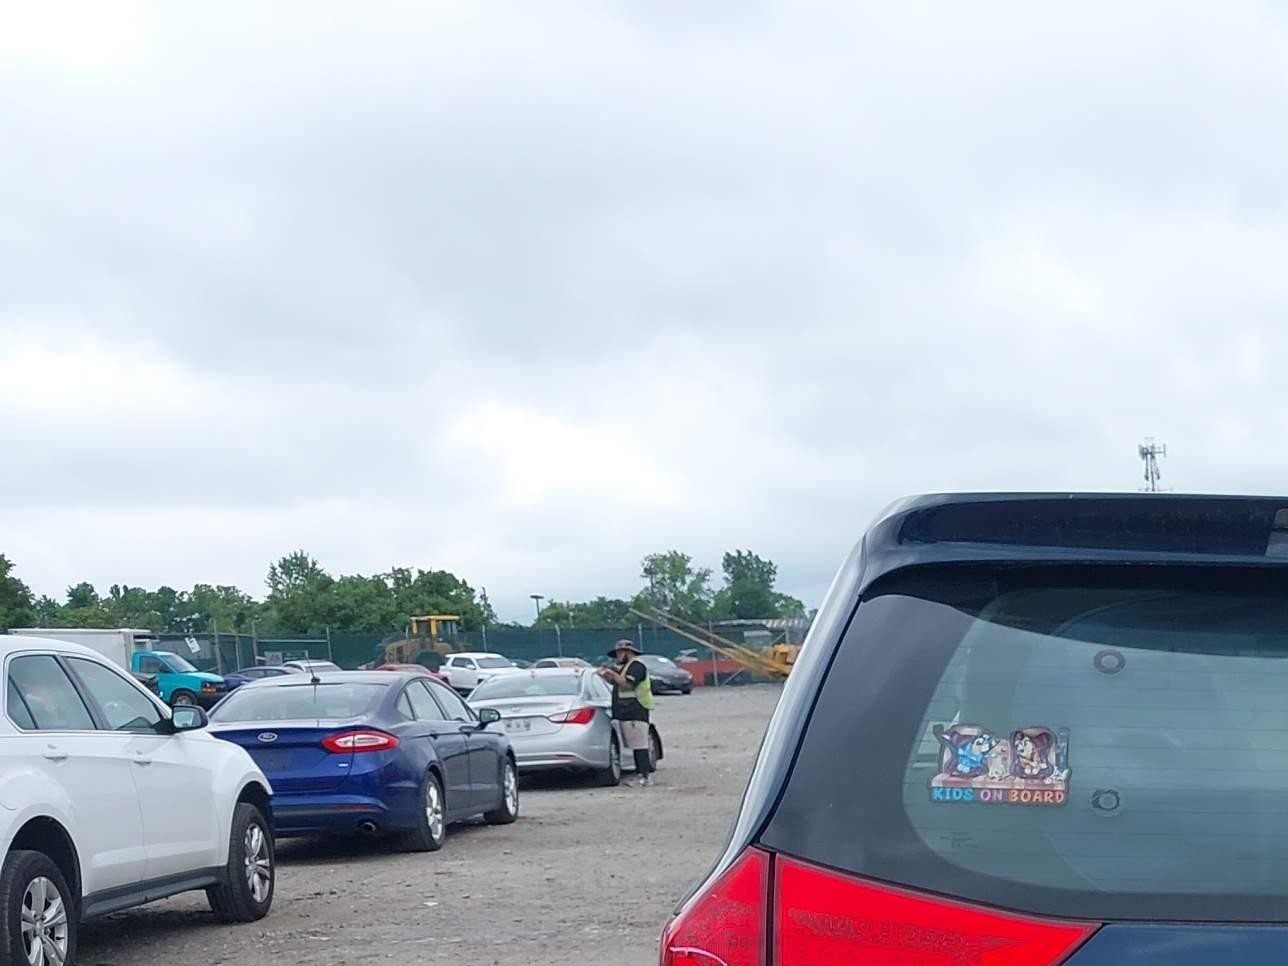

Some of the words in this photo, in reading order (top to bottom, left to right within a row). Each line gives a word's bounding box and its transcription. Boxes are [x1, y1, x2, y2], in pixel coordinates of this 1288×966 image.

[934, 787, 973, 801] KIDS
[980, 788, 1003, 801] ON
[1009, 789, 1065, 803] BOARD
